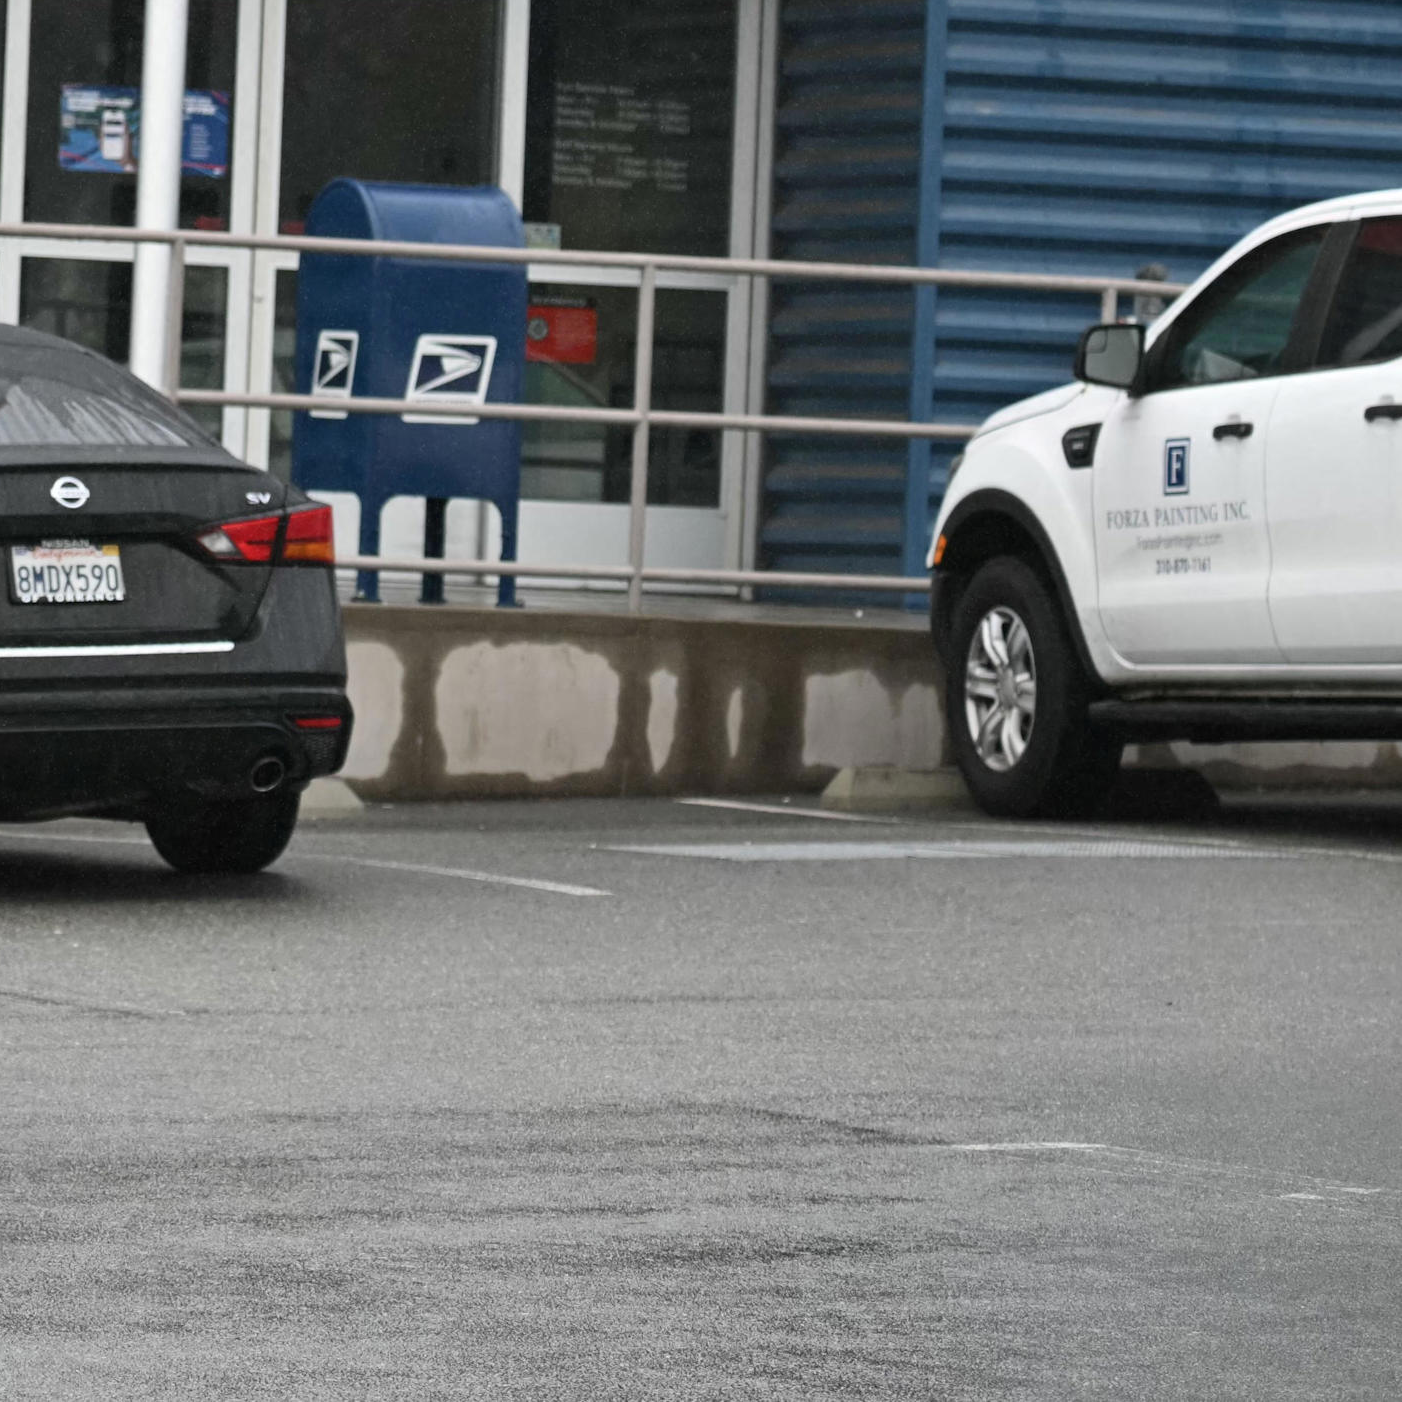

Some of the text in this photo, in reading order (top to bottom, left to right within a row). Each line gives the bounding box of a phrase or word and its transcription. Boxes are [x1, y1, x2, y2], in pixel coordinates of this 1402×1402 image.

[245, 491, 271, 505] SV
[1106, 509, 1150, 530] FORZA
[1154, 503, 1219, 528] PAINTING
[41, 539, 91, 549] NISSAN
[16, 563, 120, 595] 8MDX590
